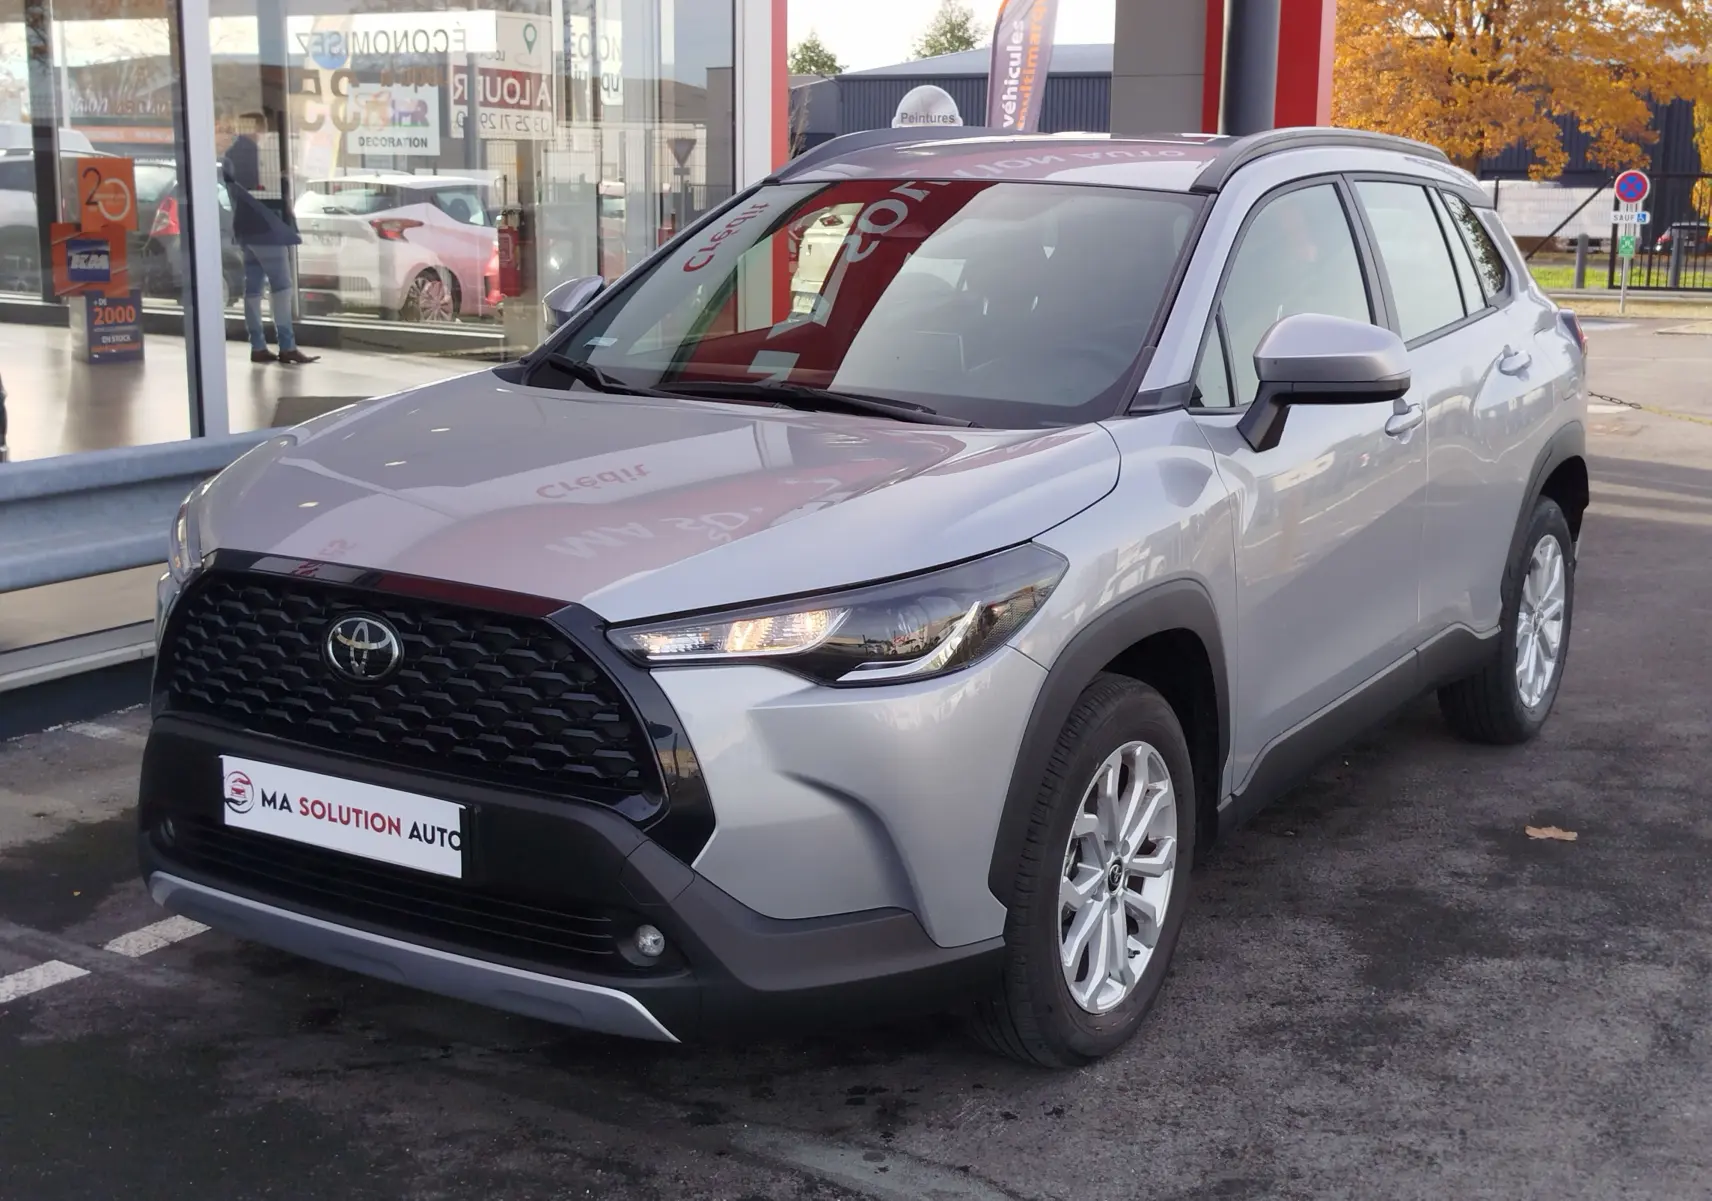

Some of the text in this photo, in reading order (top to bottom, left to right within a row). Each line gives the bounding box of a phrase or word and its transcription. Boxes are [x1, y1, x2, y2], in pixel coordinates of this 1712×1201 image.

[1001, 20, 1024, 128] véhicules
[900, 112, 956, 124] Peintures
[1613, 214, 1635, 222] SAUF
[93, 305, 136, 325] 2000
[260, 788, 462, 851] MA SOLUTION AUTO
